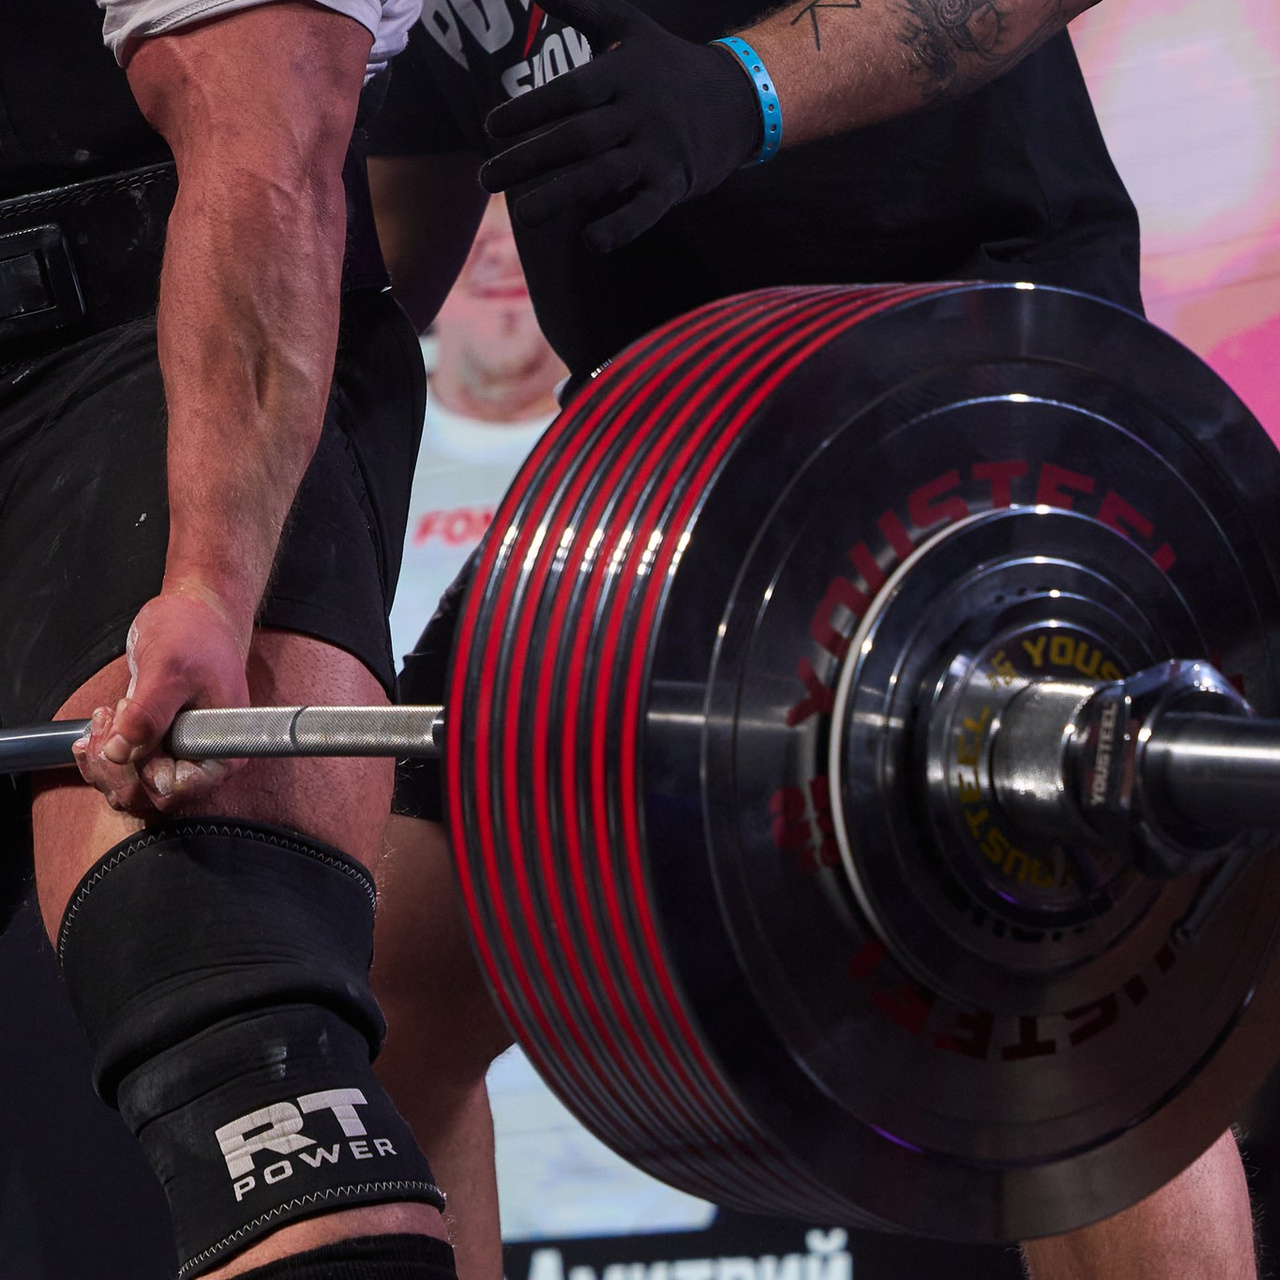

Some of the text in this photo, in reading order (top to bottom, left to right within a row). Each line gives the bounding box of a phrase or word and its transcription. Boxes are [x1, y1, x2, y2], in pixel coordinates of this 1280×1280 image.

[787, 461, 1178, 727] YOUSTEE
[215, 1088, 368, 1180] RT
[233, 1138, 397, 1202] POWER
